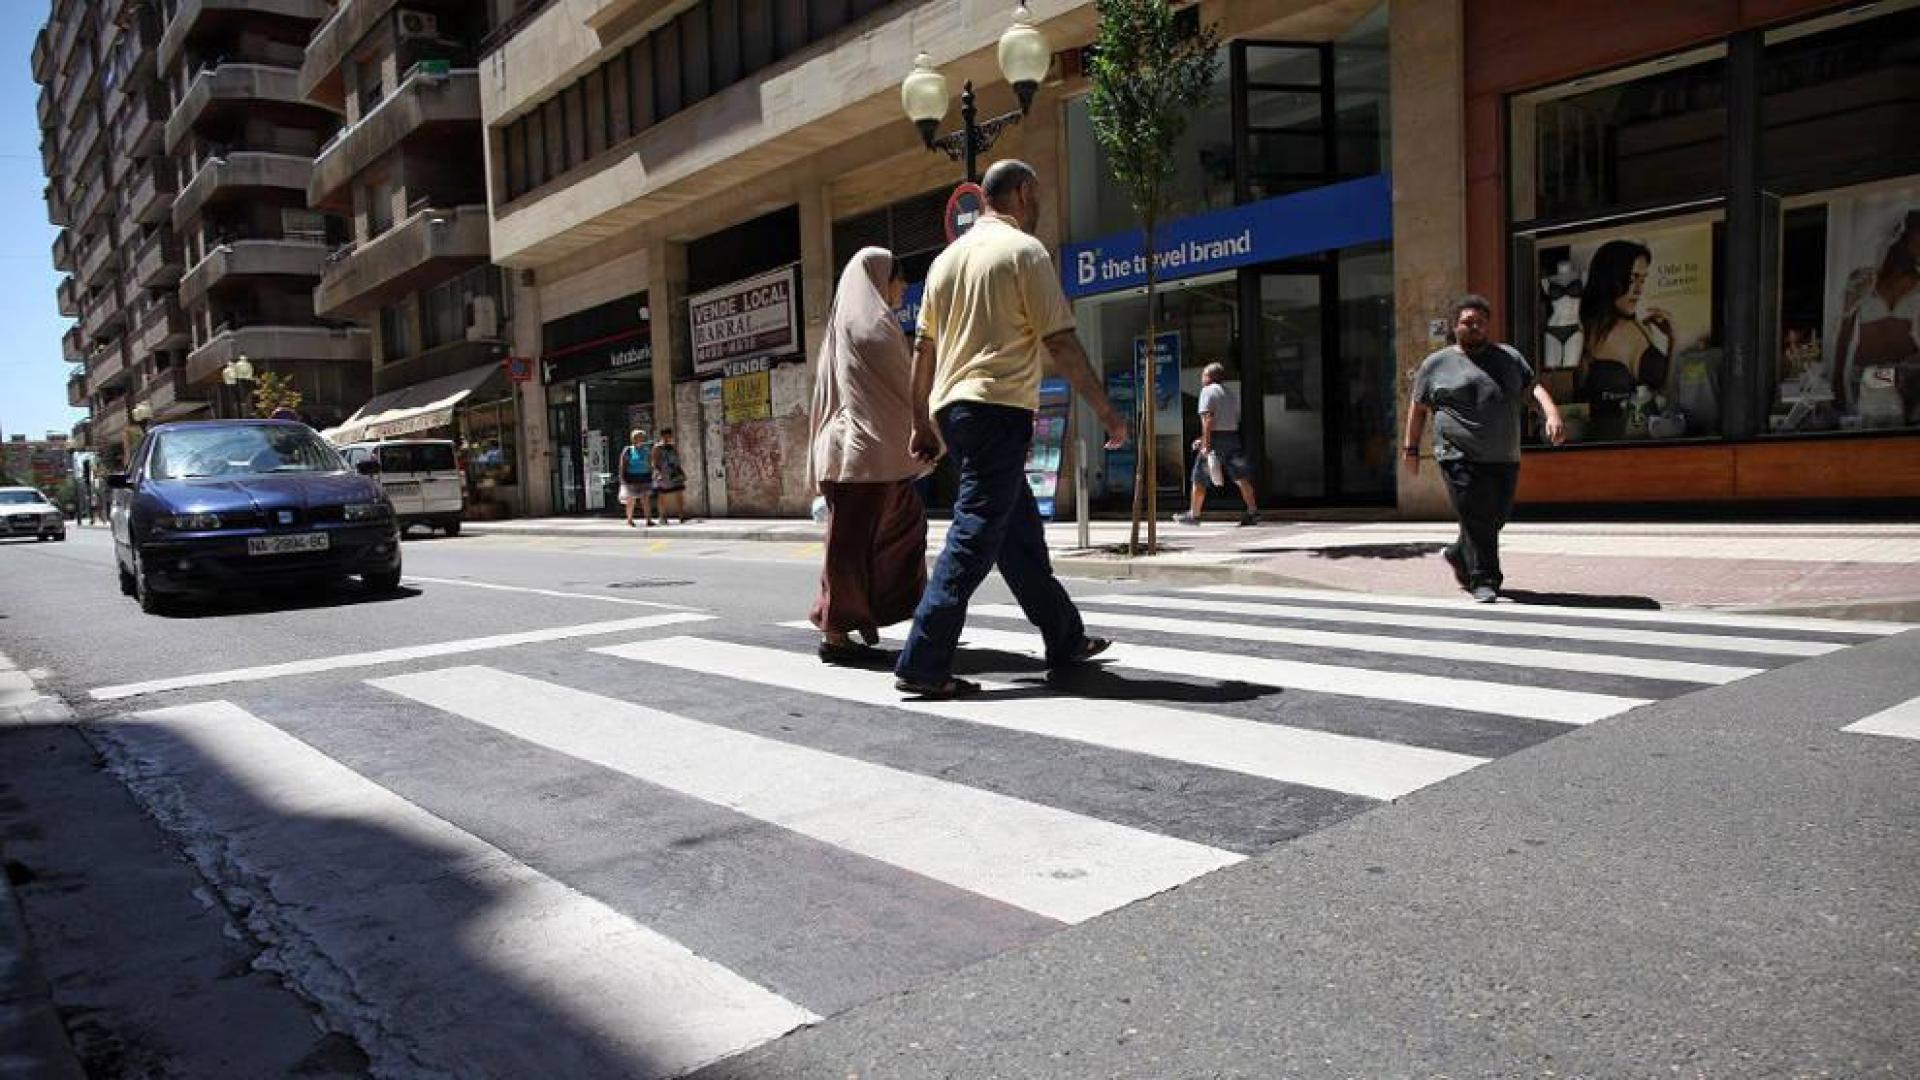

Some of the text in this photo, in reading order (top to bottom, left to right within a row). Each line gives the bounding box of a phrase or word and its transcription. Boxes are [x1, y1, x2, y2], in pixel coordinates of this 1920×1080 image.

[1101, 258, 1130, 280] the
[1190, 229, 1251, 262] brand
[693, 281, 788, 325] VENDE LOCAL
[722, 356, 770, 376] VENDE
